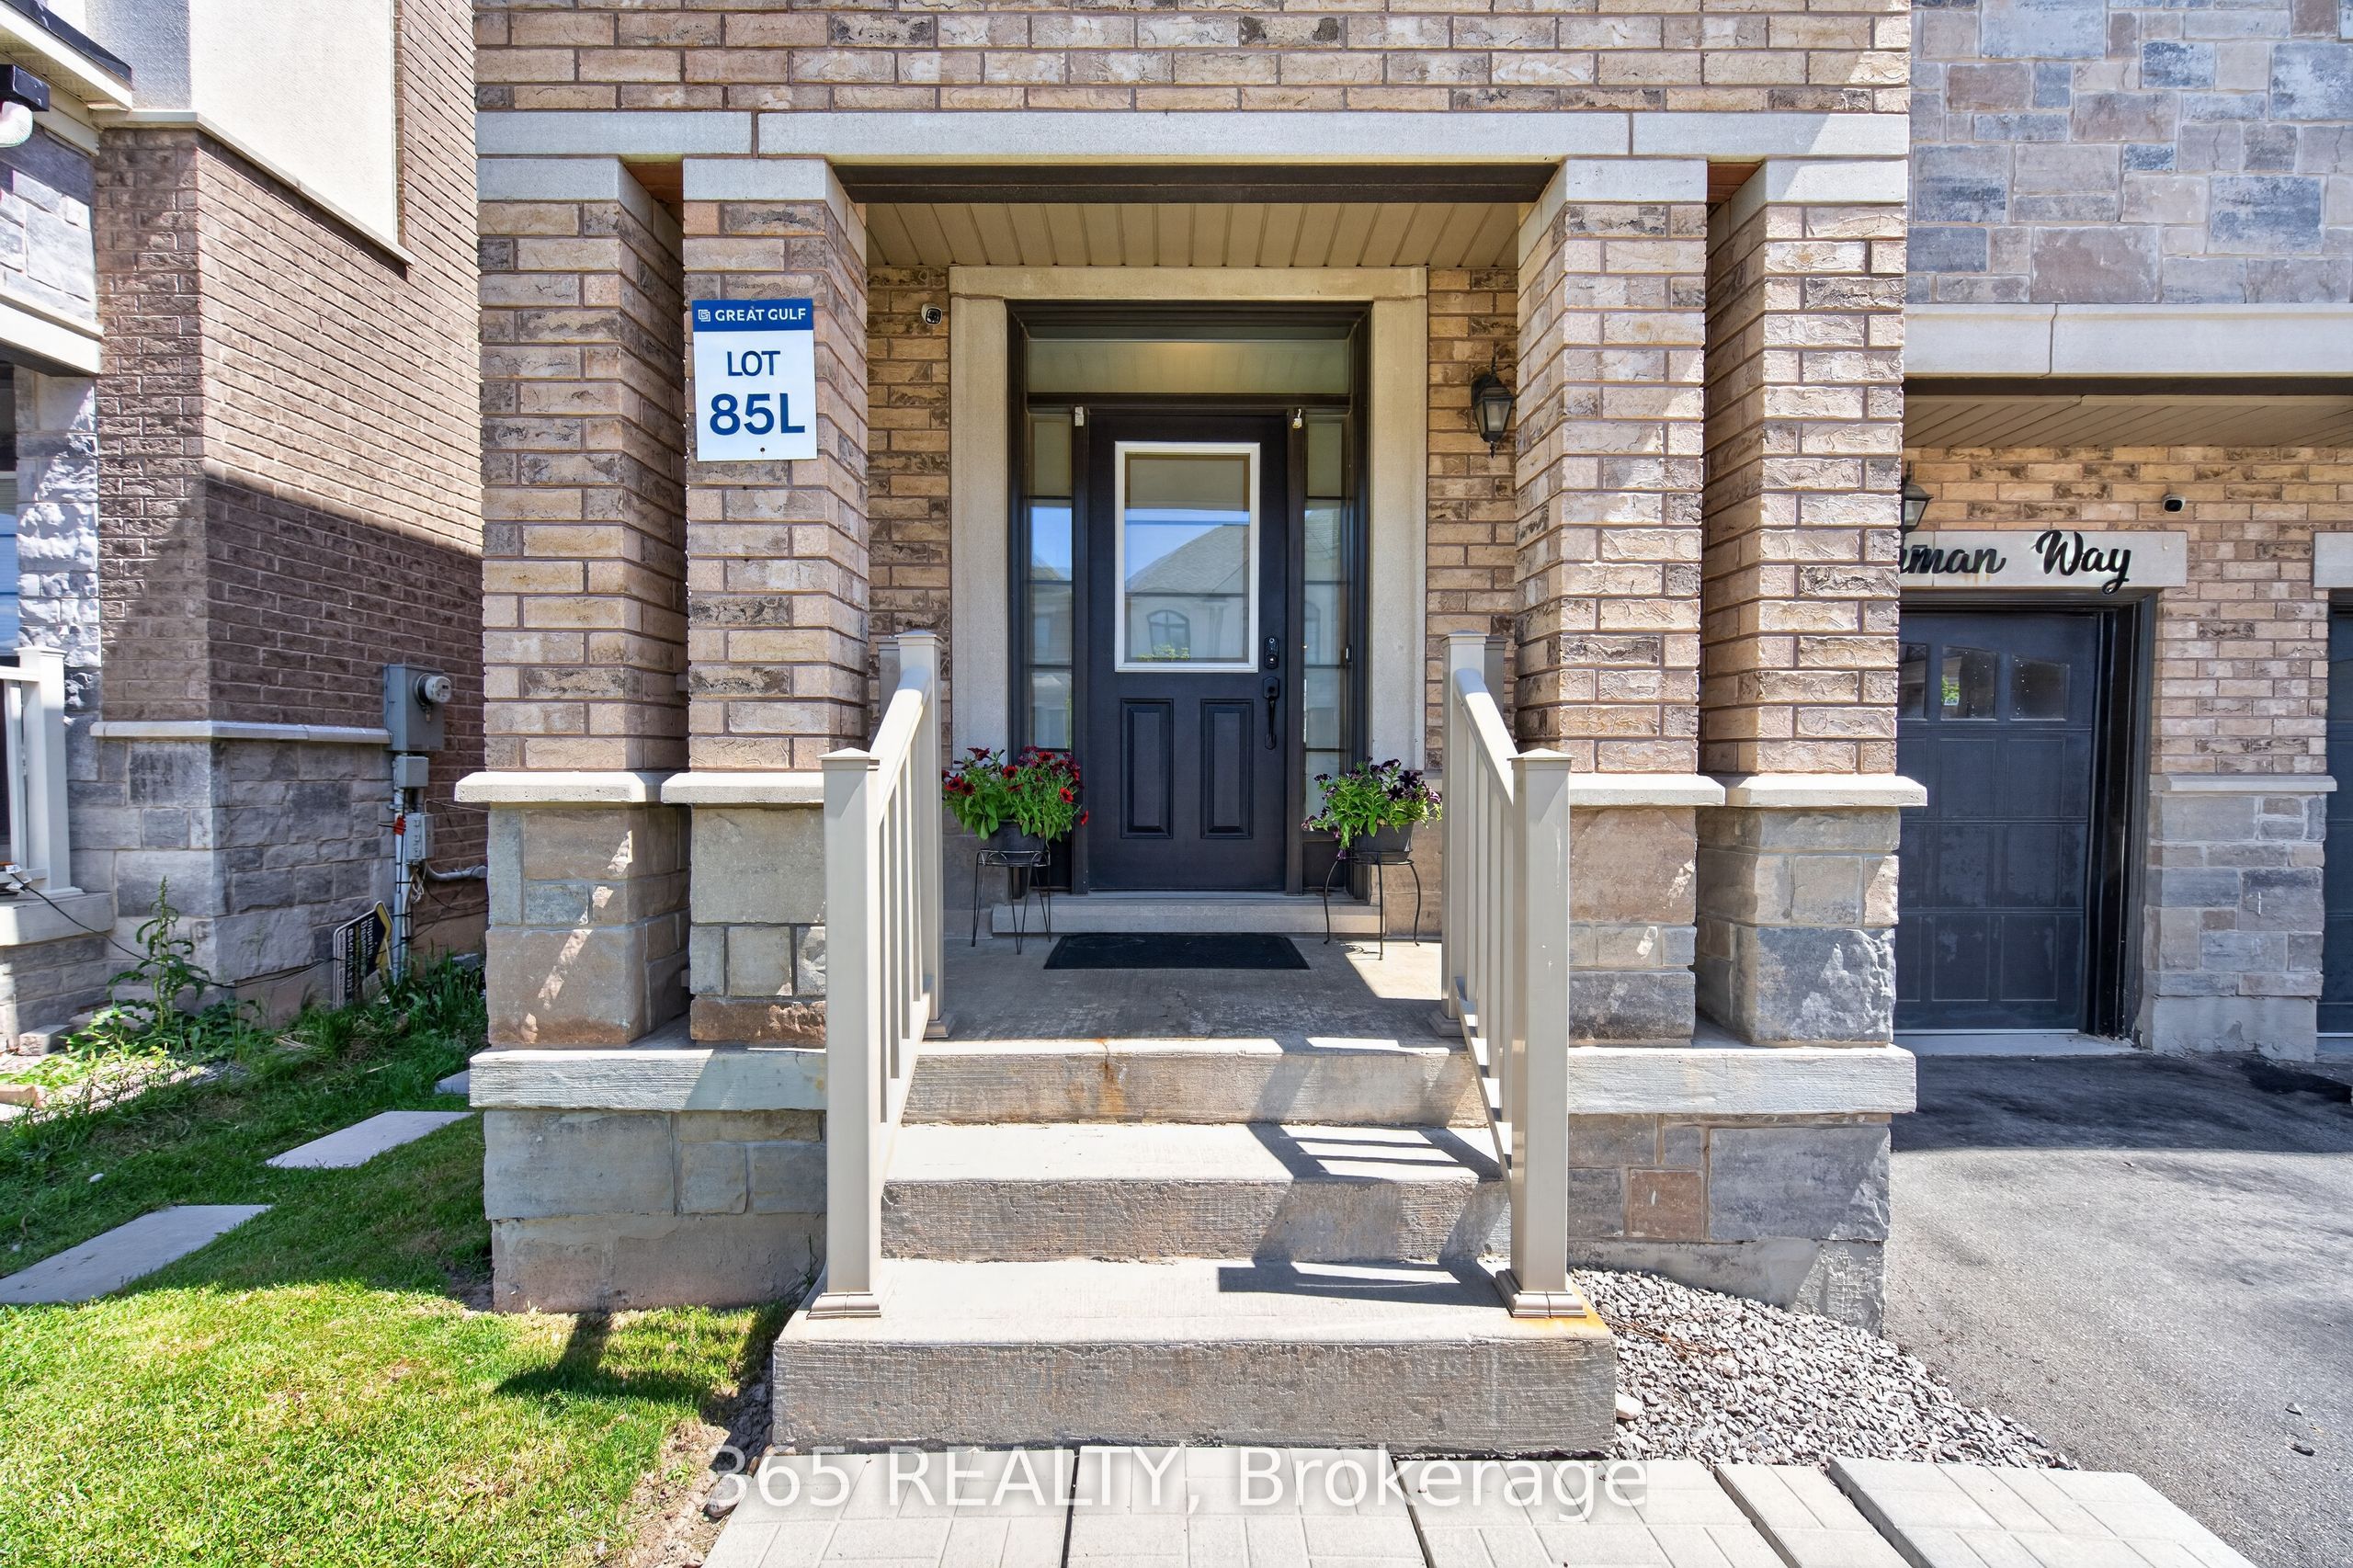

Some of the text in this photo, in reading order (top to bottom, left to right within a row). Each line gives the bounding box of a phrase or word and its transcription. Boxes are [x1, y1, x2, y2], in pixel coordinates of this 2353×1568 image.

[714, 308, 806, 322] GREAT GULF
[727, 350, 781, 377] LOT
[710, 392, 805, 436] 85L
[2034, 529, 2131, 595] Way
